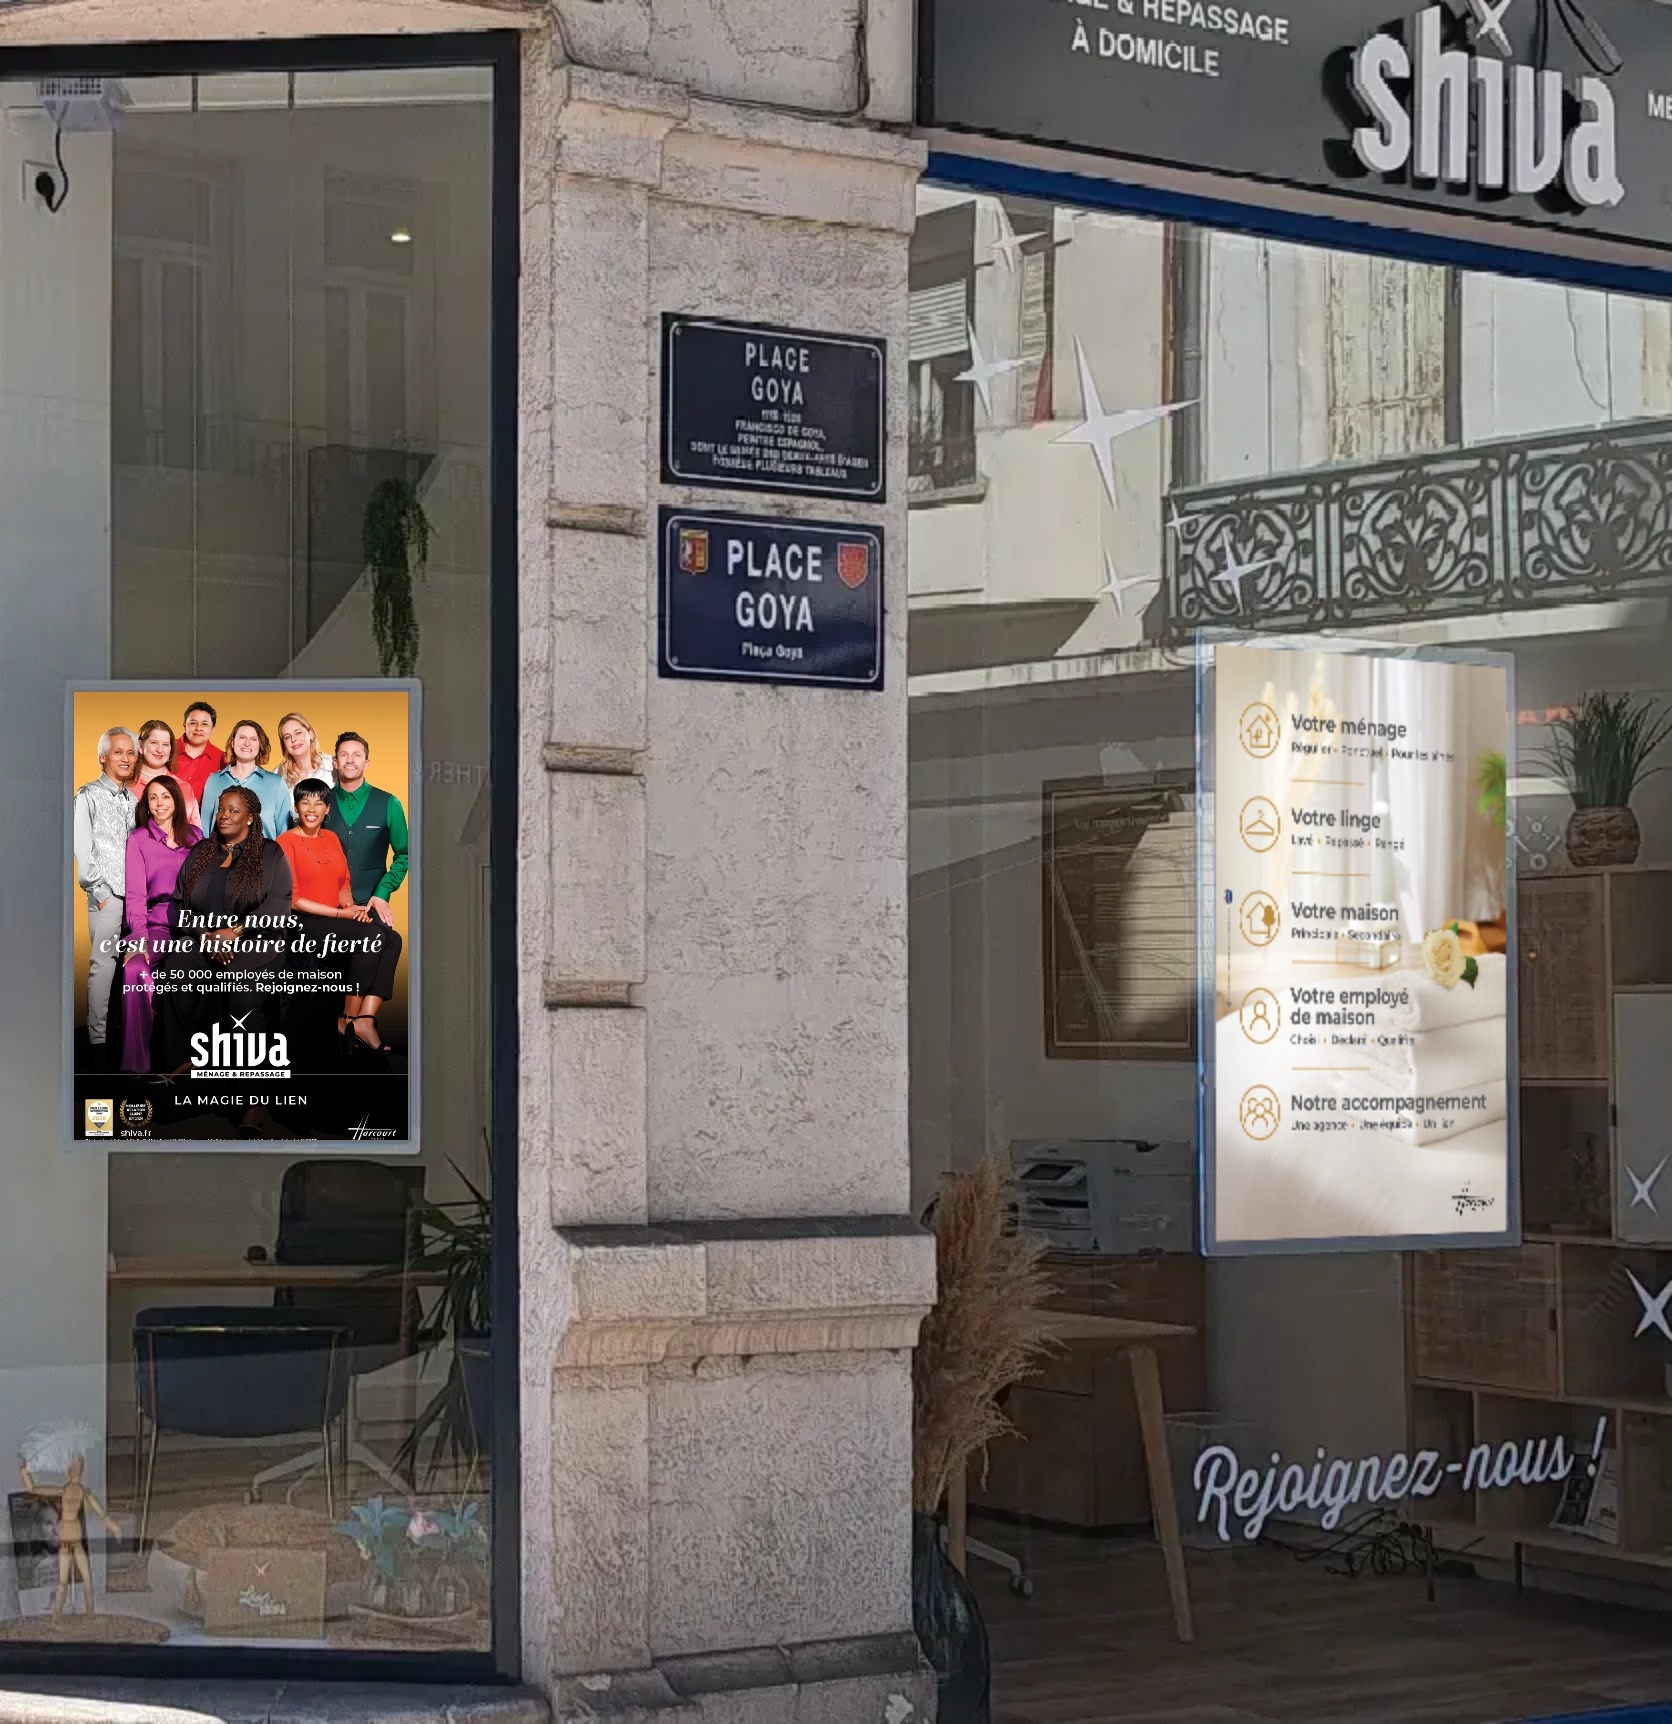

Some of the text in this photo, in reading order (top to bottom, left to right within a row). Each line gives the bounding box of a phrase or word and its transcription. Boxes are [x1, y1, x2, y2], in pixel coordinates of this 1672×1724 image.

[1143, 0, 1289, 45] REPASSAGE
[1071, 17, 1220, 76] À DOMICILE
[1352, 4, 1624, 207] shiva
[745, 342, 810, 373] PLACE
[751, 376, 804, 405] GOYA
[727, 539, 823, 582] PLACE
[736, 591, 814, 632] GOYA
[775, 644, 803, 661] Goya
[1291, 714, 1407, 741] Votre ménage
[1291, 808, 1381, 833] Votre linge
[177, 909, 304, 931] Entre nous,
[1291, 901, 1399, 921] Votre maison
[152, 938, 193, 953] une
[199, 934, 286, 953] histoire
[291, 933, 317, 953] de
[317, 933, 382, 959] fierté
[151, 969, 167, 980] de
[169, 970, 185, 980] 50
[188, 970, 213, 980] 000
[215, 968, 275, 983] employés
[278, 969, 294, 980] de
[297, 969, 342, 980] maison
[122, 982, 178, 995] protégés
[181, 983, 194, 993] et
[197, 982, 253, 995] qualifiés.
[255, 982, 353, 995] Rejoignez-nous
[1290, 987, 1409, 1008] Votre employé
[1290, 1007, 1375, 1025] de maison
[190, 1021, 291, 1068] shiva
[238, 1070, 286, 1078] REPASSAGE
[174, 1095, 308, 1106] LA MAGIE DU LIEN
[1291, 1095, 1487, 1114] Notre accompagnement
[120, 1129, 152, 1137] shiva.fr
[1192, 1434, 1574, 1541] Rejoignez-nous
